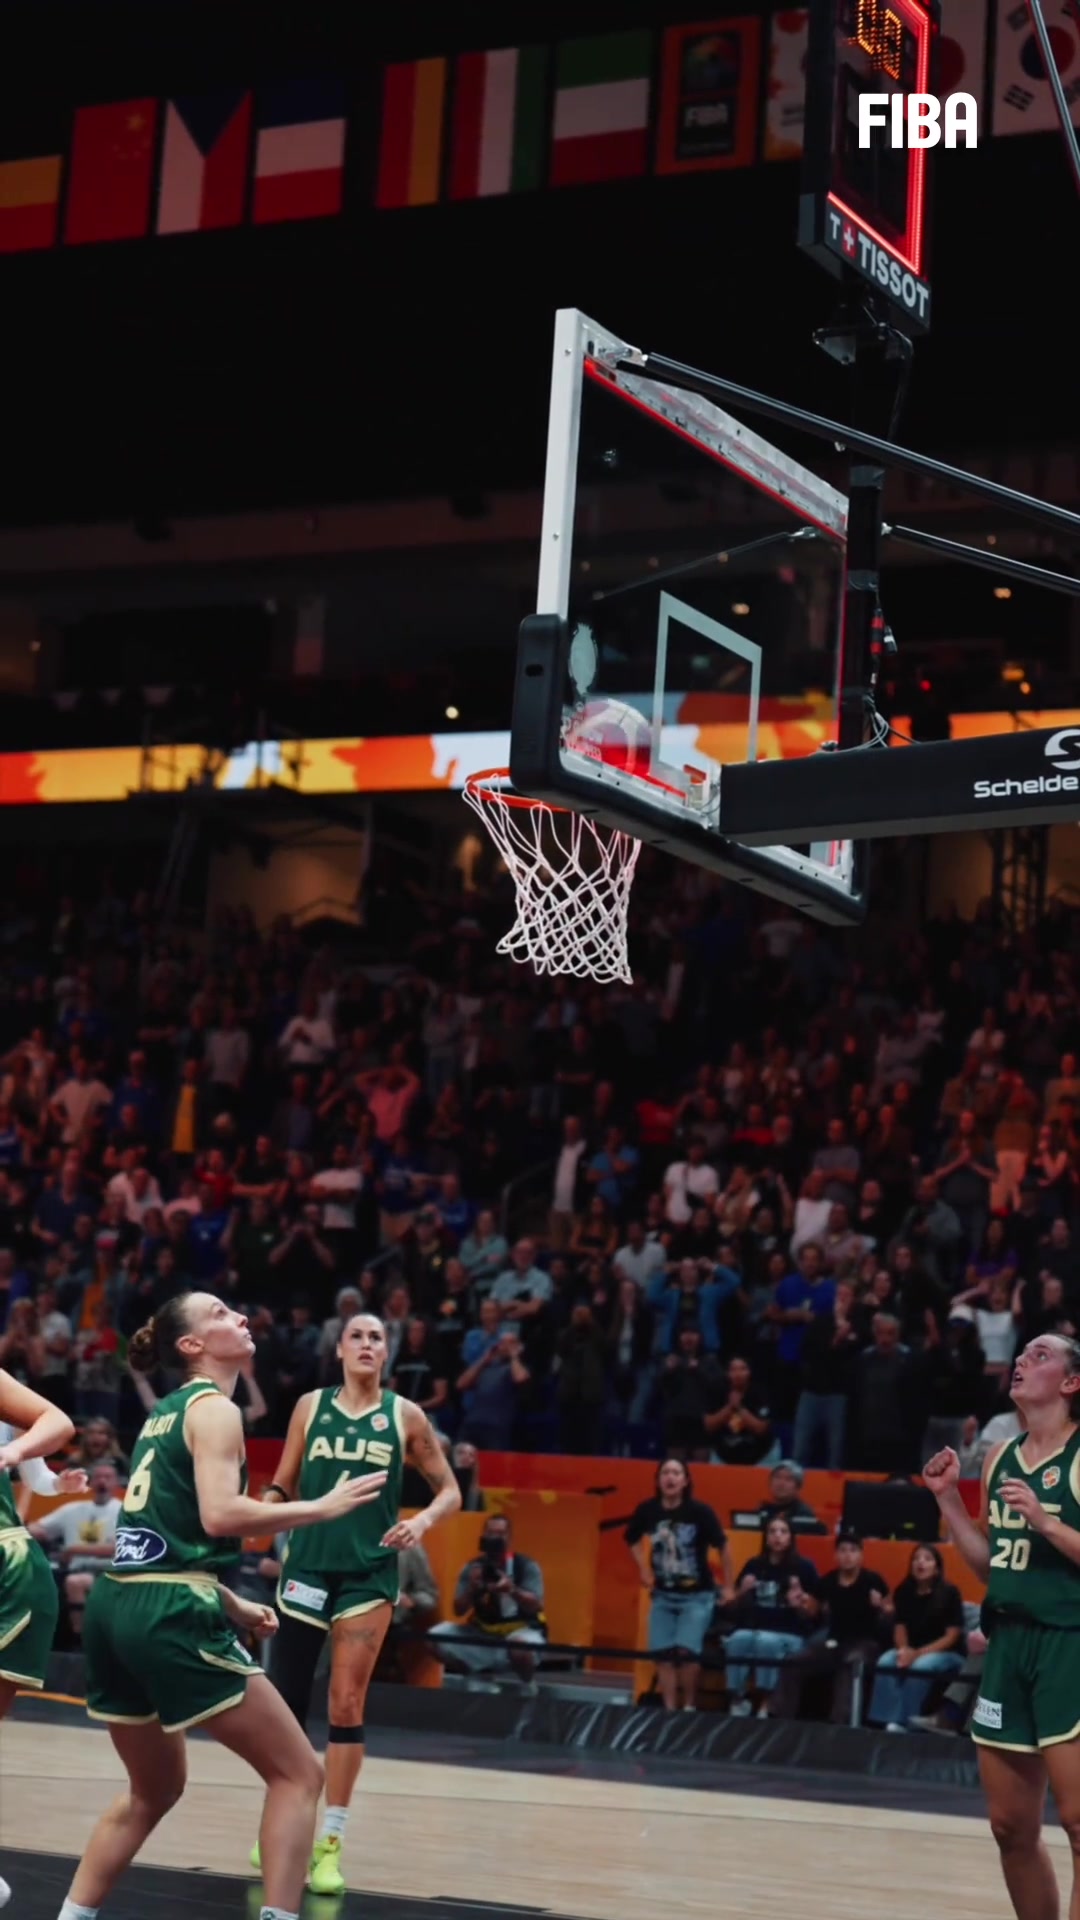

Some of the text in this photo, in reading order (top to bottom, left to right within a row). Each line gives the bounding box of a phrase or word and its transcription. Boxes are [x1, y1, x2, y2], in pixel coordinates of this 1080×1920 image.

[857, 230, 929, 318] TISSOT
[973, 773, 1080, 799] Schelde
[308, 1435, 394, 1467] AUS
[123, 1447, 155, 1512] 6
[113, 1531, 150, 1560] Ford
[990, 1537, 1031, 1571] 20
